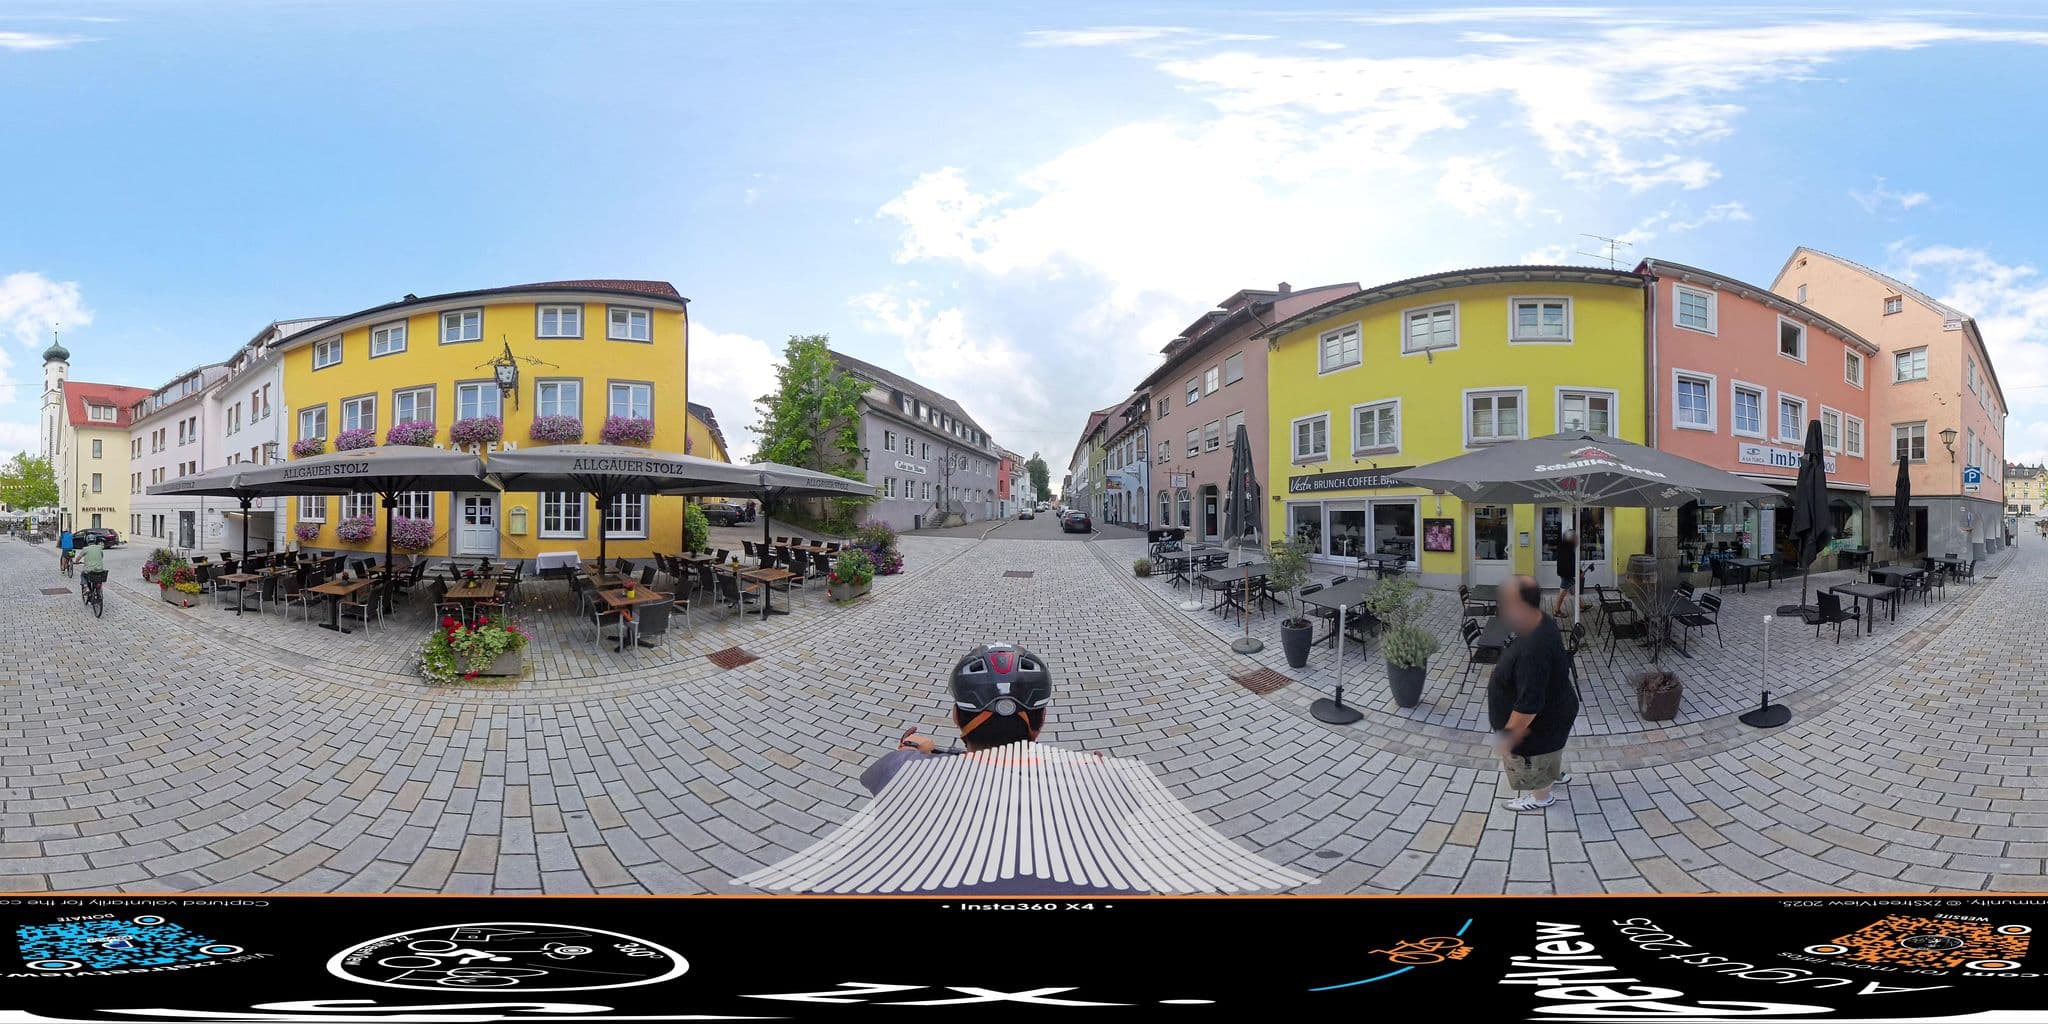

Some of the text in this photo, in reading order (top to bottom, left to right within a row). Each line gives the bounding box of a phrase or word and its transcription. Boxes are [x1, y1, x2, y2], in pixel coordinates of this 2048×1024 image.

[1770, 448, 1801, 467] imbi
[333, 462, 369, 474] STOLZ
[645, 462, 683, 475] STOLZ
[1968, 472, 1977, 482] P
[1290, 477, 1312, 492] Vesta
